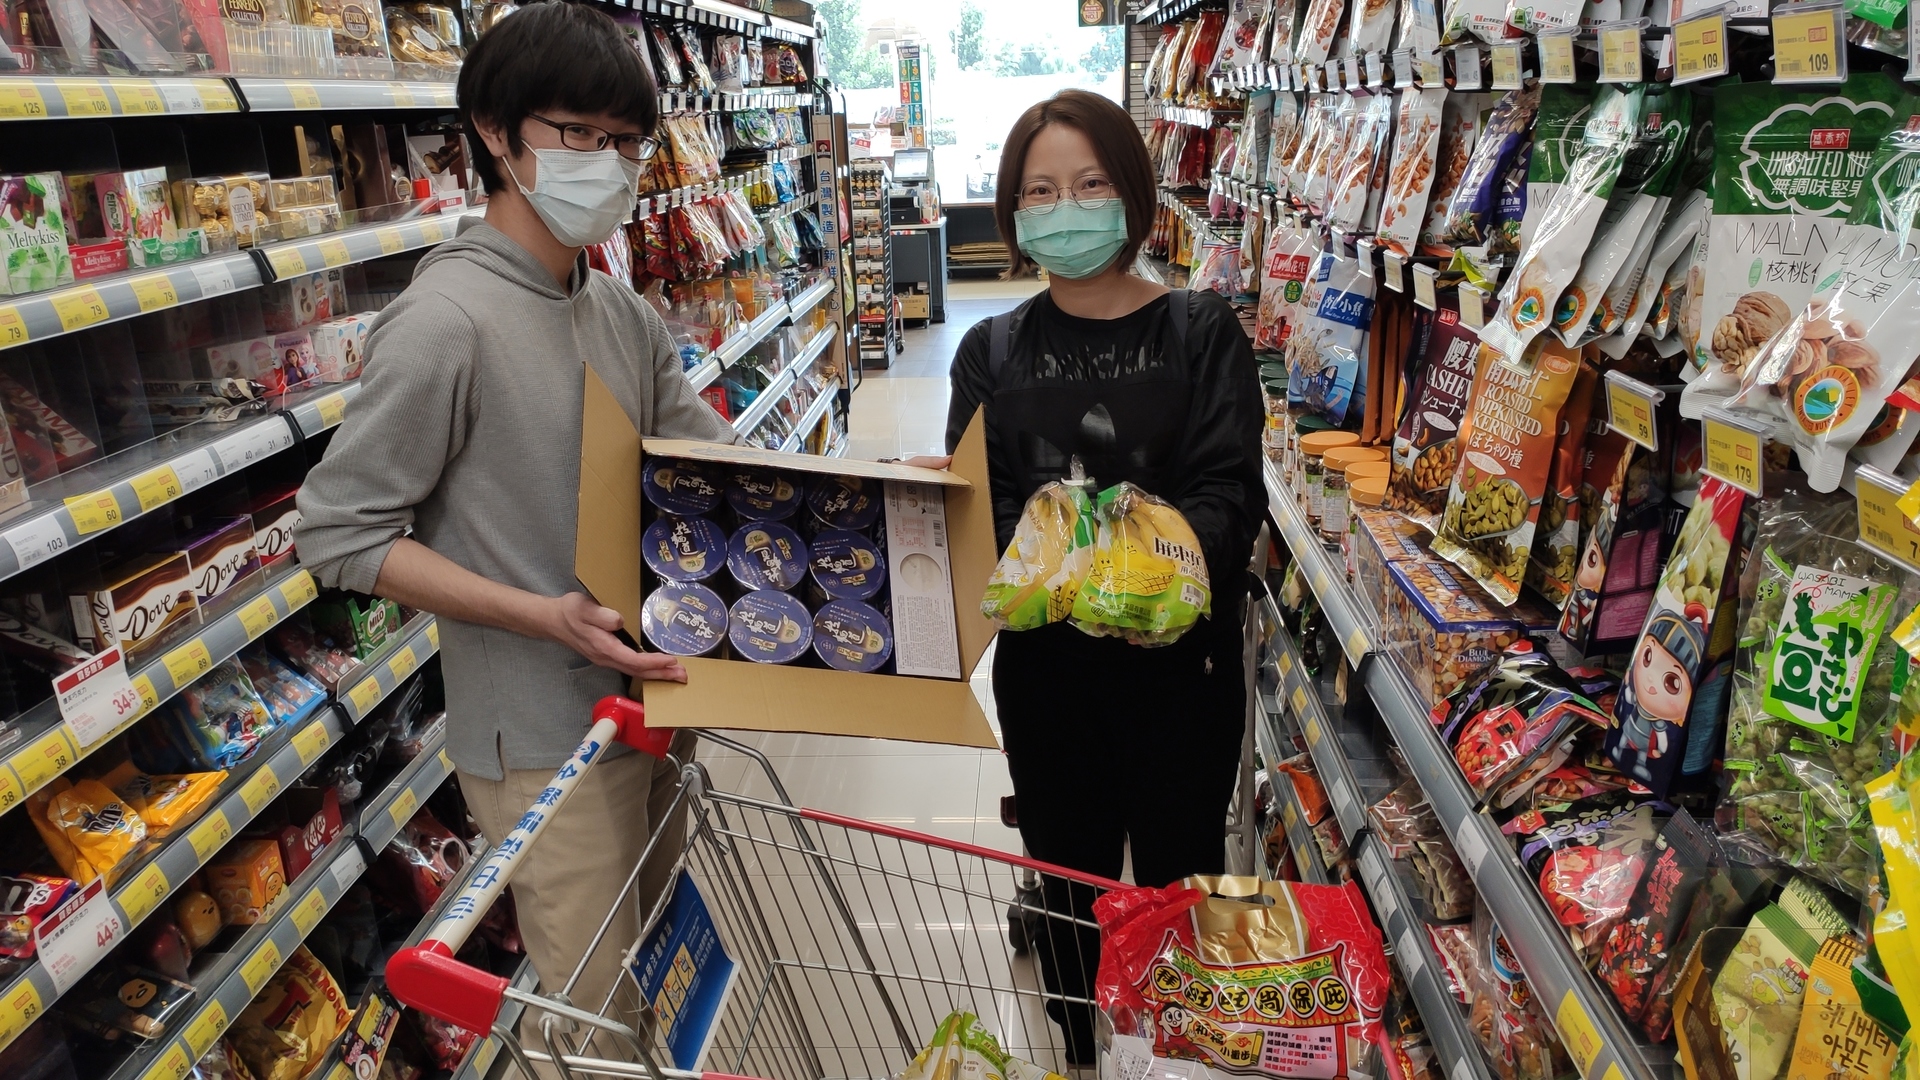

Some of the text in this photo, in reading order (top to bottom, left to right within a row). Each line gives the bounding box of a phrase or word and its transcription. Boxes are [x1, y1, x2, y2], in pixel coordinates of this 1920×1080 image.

[231, 11, 261, 22] COLLECTION
[345, 12, 366, 24] FERRERO
[346, 23, 368, 33] COLLECTION
[1624, 62, 1636, 74] 109
[1702, 53, 1718, 69] 109
[1808, 53, 1829, 71] 109
[24, 102, 41, 114] 125
[92, 101, 107, 112] 108
[145, 101, 158, 112] 108
[1812, 132, 1847, 146] 盛香珍
[1766, 151, 1842, 177] UNSALTED
[819, 169, 836, 234] 台灣製造
[7, 229, 60, 249] Meltykiss
[85, 255, 111, 266] Meltykiss
[163, 292, 174, 302] 79
[91, 305, 102, 316] 79
[9, 326, 21, 339] 79
[1484, 383, 1533, 415] ROASTED
[1472, 412, 1524, 446] KERNELS
[1638, 423, 1649, 438] 59
[268, 440, 276, 450] 31
[245, 450, 253, 461] 40
[204, 469, 213, 479] 71
[1734, 463, 1752, 483] 179
[167, 486, 176, 496] 60
[106, 509, 117, 521] 60
[46, 536, 63, 552] 103
[195, 552, 244, 597] Dove
[1797, 572, 1848, 588] WASABI
[1825, 586, 1860, 603] MAME
[93, 591, 114, 644] Dove
[119, 594, 178, 641] Dove
[266, 612, 275, 623] 89
[369, 610, 384, 629] MILO
[1468, 648, 1489, 657] BLUE
[198, 657, 207, 670] 89
[1816, 622, 1864, 722] わさび
[112, 690, 136, 715] 34.5
[143, 696, 154, 710] 39
[55, 755, 67, 769] 38
[266, 782, 278, 798] 129
[220, 829, 229, 841] 43
[304, 815, 326, 851] KitKat
[443, 763, 579, 921] 全聯福利中心
[154, 884, 164, 897] 43
[96, 918, 119, 948] 44.5
[270, 957, 278, 970] 65
[23, 1003, 36, 1019] 83
[216, 1018, 224, 1031] 59
[1820, 998, 1892, 1057] 허니버터
[1822, 1033, 1873, 1075] 아몬드
[175, 1063, 185, 1078] 55
